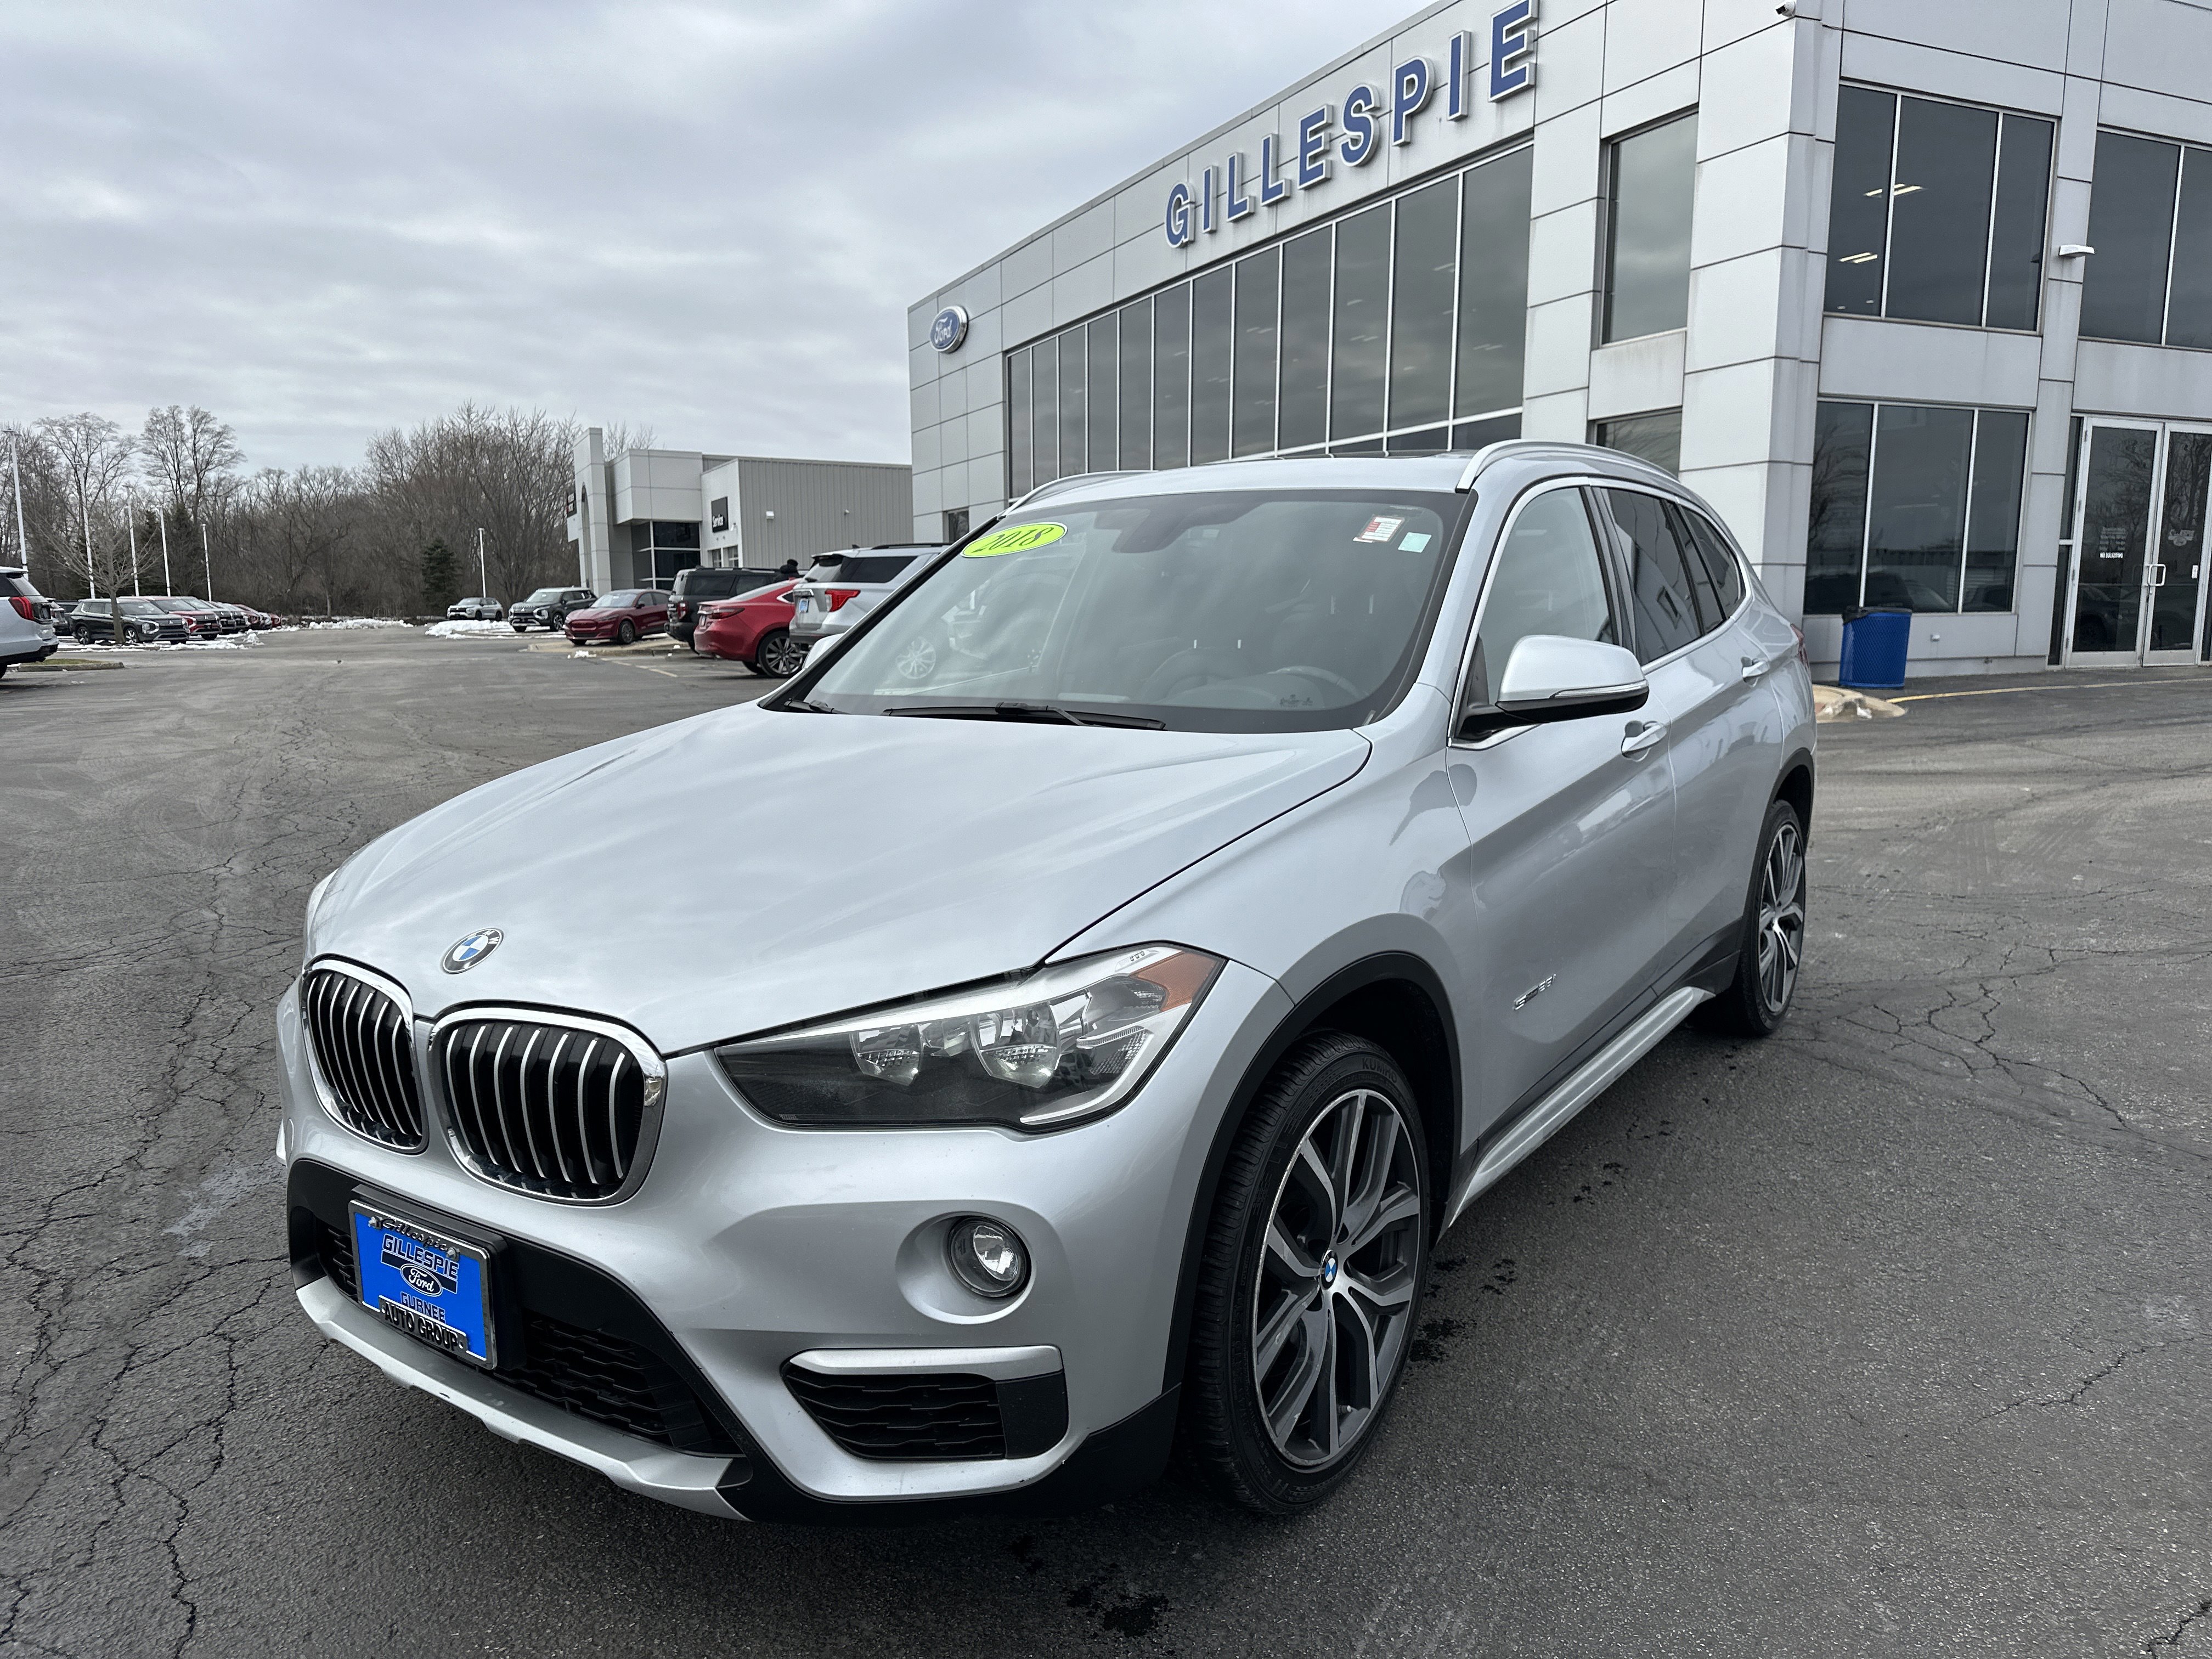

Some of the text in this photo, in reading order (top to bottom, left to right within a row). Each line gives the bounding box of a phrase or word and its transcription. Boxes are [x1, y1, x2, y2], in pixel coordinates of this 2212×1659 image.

[1164, 0, 1538, 249] GILLESPIE
[970, 527, 1054, 554] 2018
[1361, 1056, 1397, 1084] KUMHO
[382, 1218, 448, 1252] Gillespie
[382, 1233, 459, 1280] GILLESPIE
[409, 1268, 435, 1292] Ford
[400, 1291, 447, 1324] GURNEE
[385, 1302, 458, 1351] AUTO GROUP
